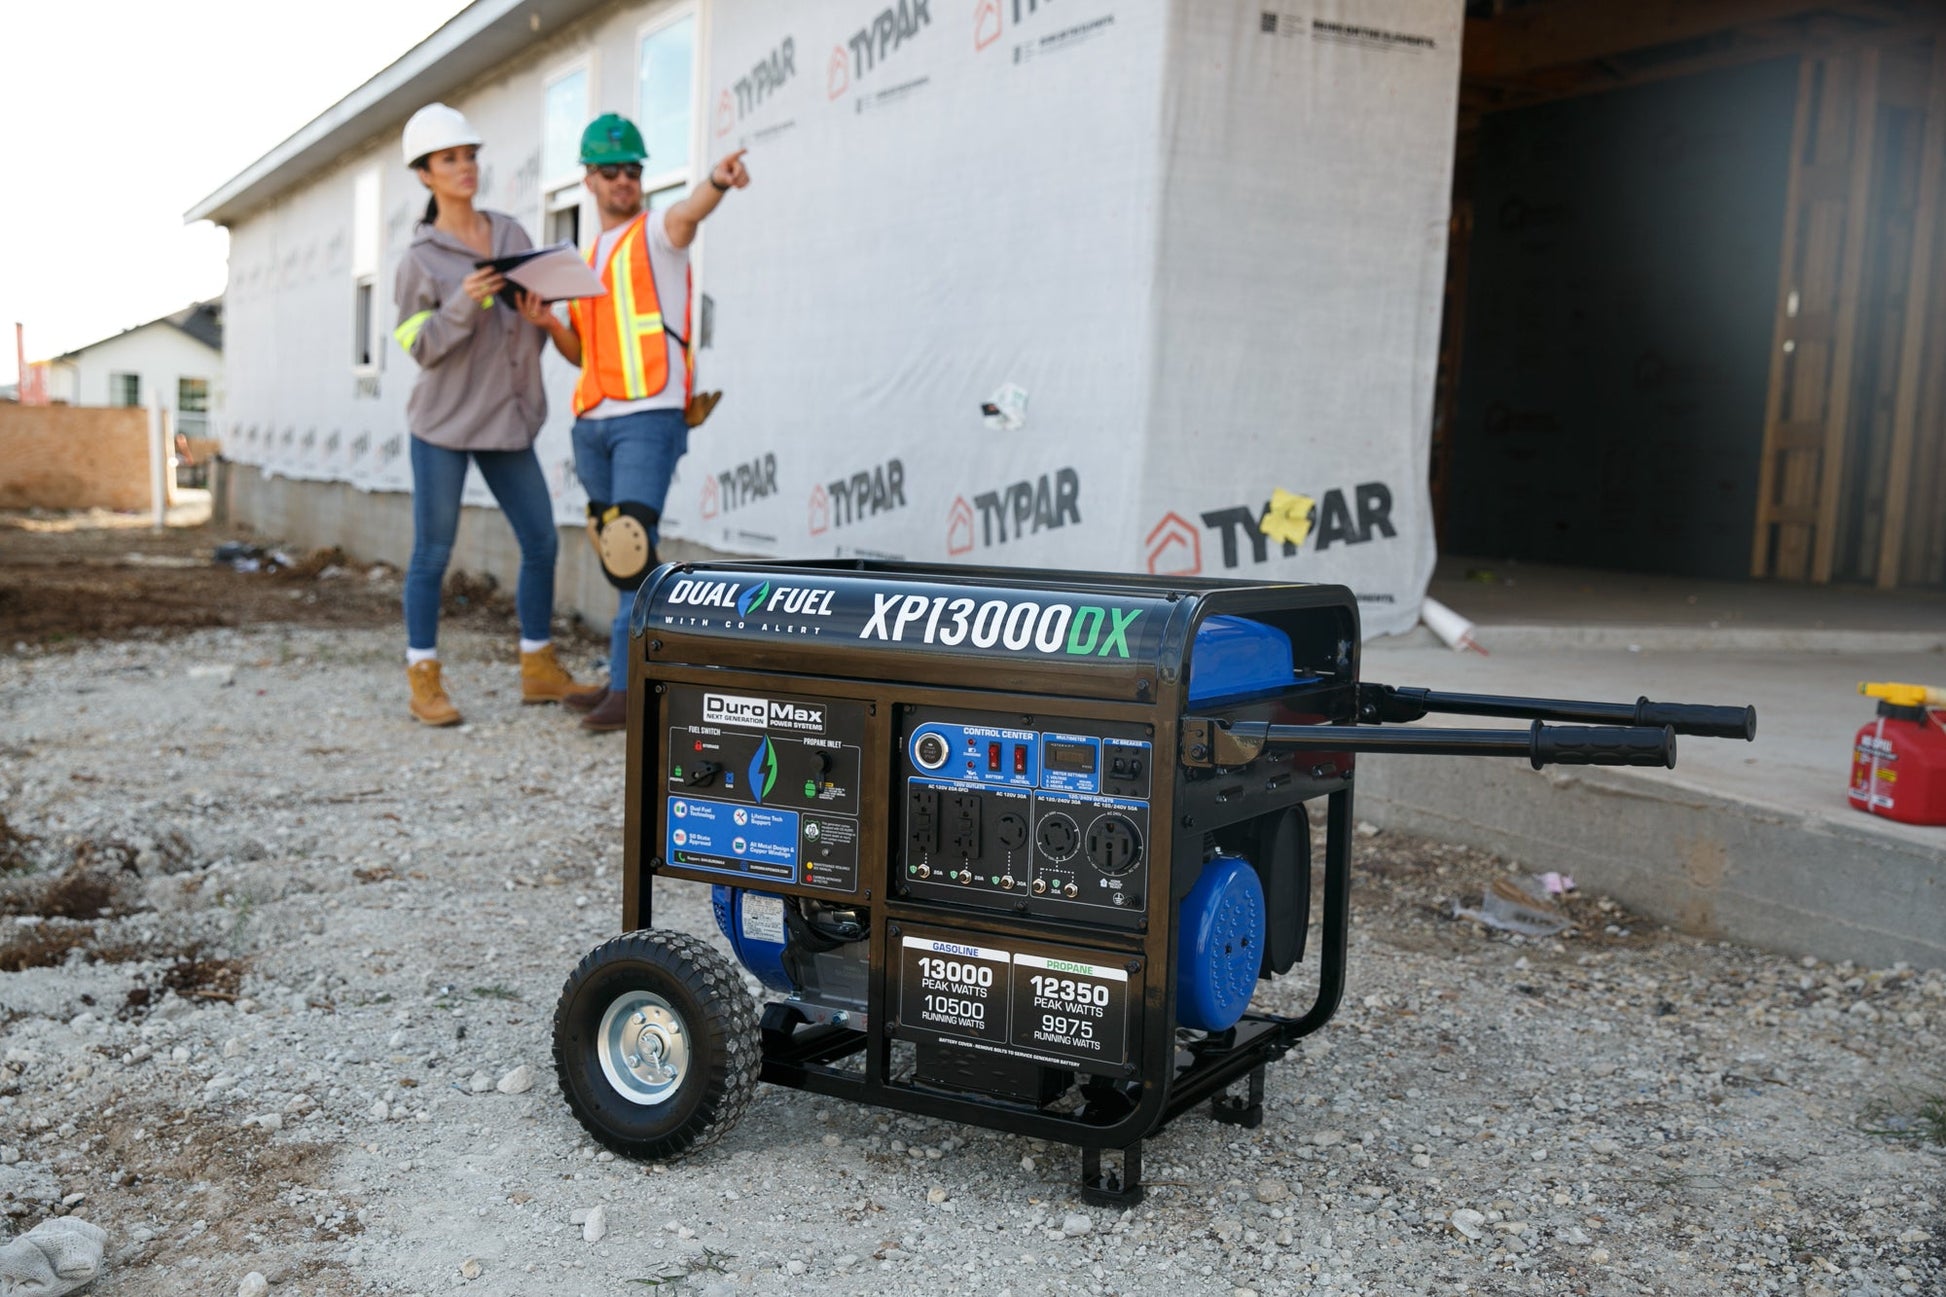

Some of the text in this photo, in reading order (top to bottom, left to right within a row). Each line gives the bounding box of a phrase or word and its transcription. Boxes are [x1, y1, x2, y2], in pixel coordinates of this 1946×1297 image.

[733, 35, 797, 119] TYPAR
[718, 452, 777, 512] TYPAR
[828, 458, 907, 527] TYPAR
[973, 466, 1082, 547] TYPAR
[667, 579, 836, 616] DUAL FUEL
[664, 616, 821, 635] WITH CO ALERT
[858, 593, 1144, 658] XP13000DX
[724, 715, 764, 725] GENERATION
[769, 720, 823, 731] POWER SYSTEMS
[688, 725, 721, 736] FUEL SWITCH
[963, 727, 1034, 740] CONTROL CENTER
[803, 737, 842, 749] PROPANE INLET
[690, 811, 716, 820] Technology
[751, 813, 771, 821] Lifetime
[751, 819, 772, 827] Support
[689, 839, 712, 847] Approved
[749, 847, 791, 859] Copper Windings
[757, 842, 773, 850] Metal
[772, 844, 790, 853] Design
[932, 942, 979, 957] GASOLINE
[918, 957, 993, 988] 13000
[1046, 959, 1094, 975] PROPANE
[921, 978, 988, 998] PEAK WATTS
[1030, 975, 1109, 1007] 12350
[924, 994, 985, 1020] 10500
[1034, 996, 1103, 1018] PEAK WATTS
[921, 1010, 985, 1030] RUNNING WATTS
[1042, 1014, 1093, 1039] 9975
[1034, 1030, 1101, 1050] RUNNING WATTS
[938, 1037, 958, 1045] BATTERY
[957, 1040, 973, 1048] COVER
[974, 1043, 994, 1052] REMOVE
[1014, 1050, 1033, 1059] SERVICE
[1033, 1054, 1060, 1063] GENERATOR
[1059, 1058, 1080, 1067] BATTERY
